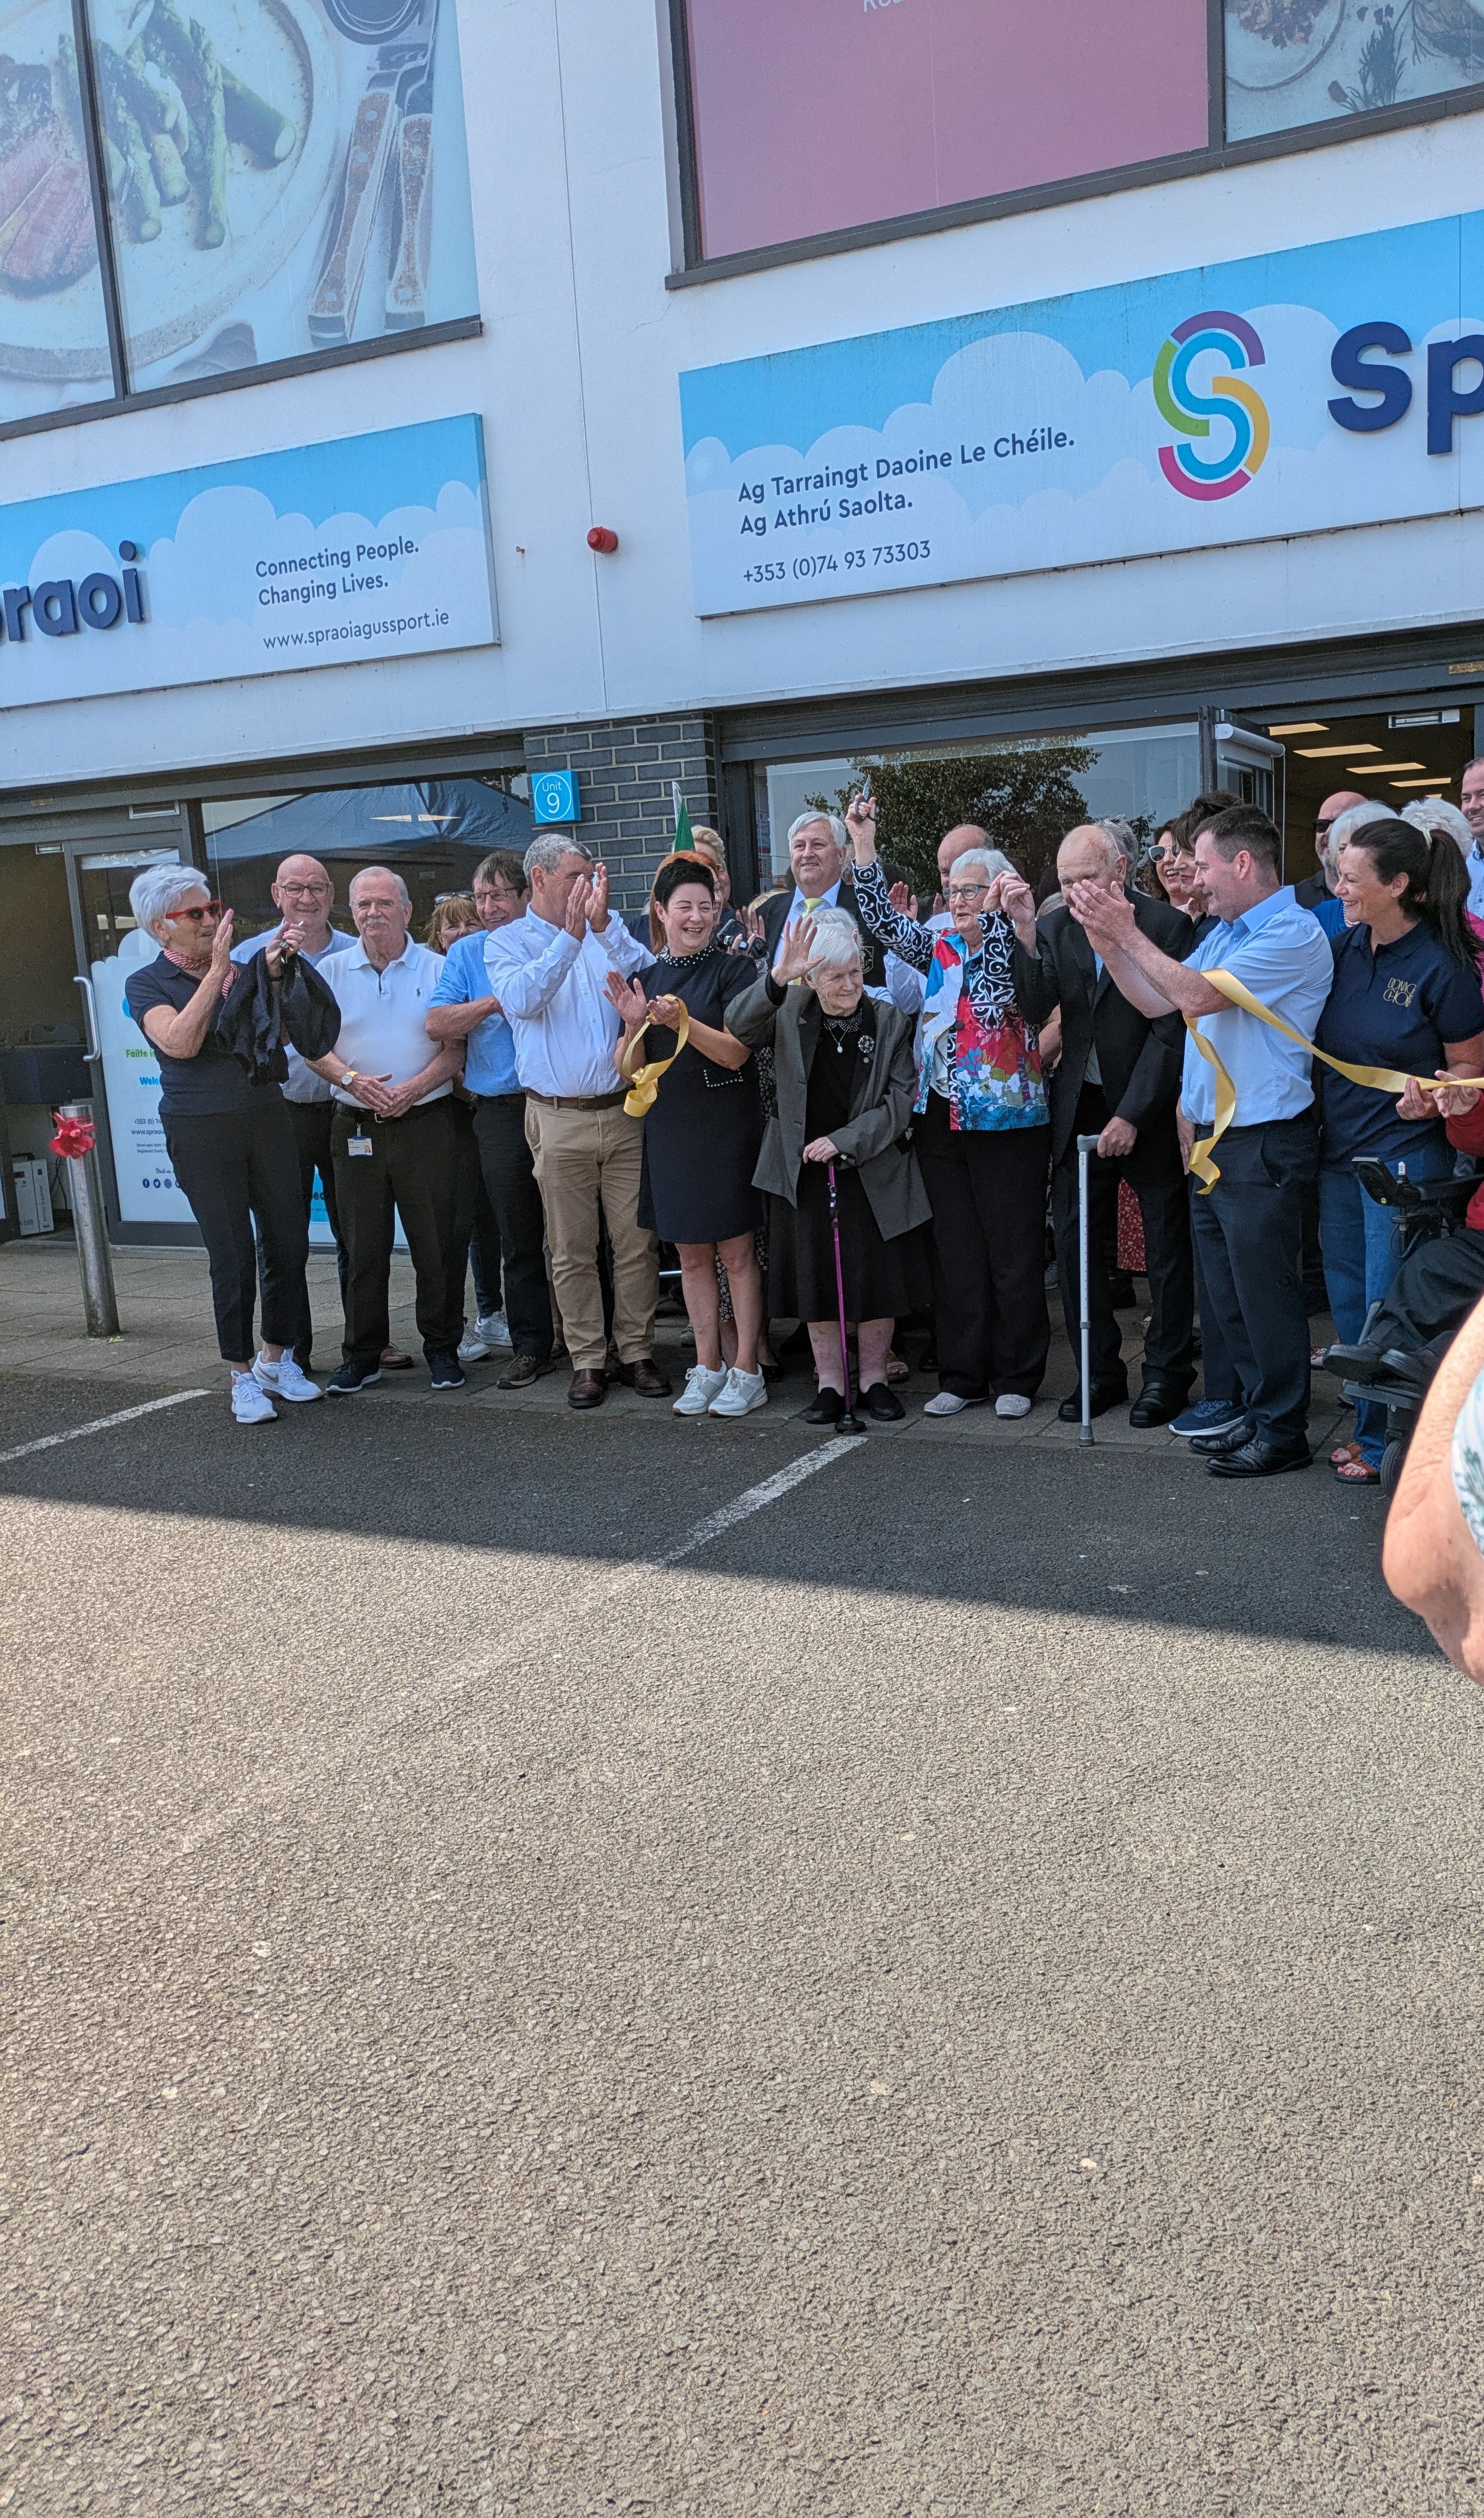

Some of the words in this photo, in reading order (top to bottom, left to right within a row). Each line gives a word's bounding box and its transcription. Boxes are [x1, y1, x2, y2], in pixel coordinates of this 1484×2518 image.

[738, 482, 765, 504] Ag
[771, 463, 869, 496] Tarraingt
[875, 449, 952, 479] Daoine
[960, 444, 985, 465] Le
[994, 426, 1075, 459] Chéile.
[740, 515, 766, 536] Ag
[774, 498, 831, 529] Athrú
[838, 491, 913, 518] Saolta.
[255, 547, 351, 578] Connecting
[355, 536, 419, 562] People.
[743, 561, 786, 583] +353
[793, 554, 838, 580] (0)74
[844, 549, 866, 570] 93
[872, 540, 931, 566] 73303
[0, 540, 144, 643] raoi
[259, 579, 337, 606] Changing
[341, 573, 389, 594] Lives.
[263, 608, 450, 650] www.spraoiagussport.ie
[542, 780, 562, 792] Unit
[547, 792, 560, 814] 9
